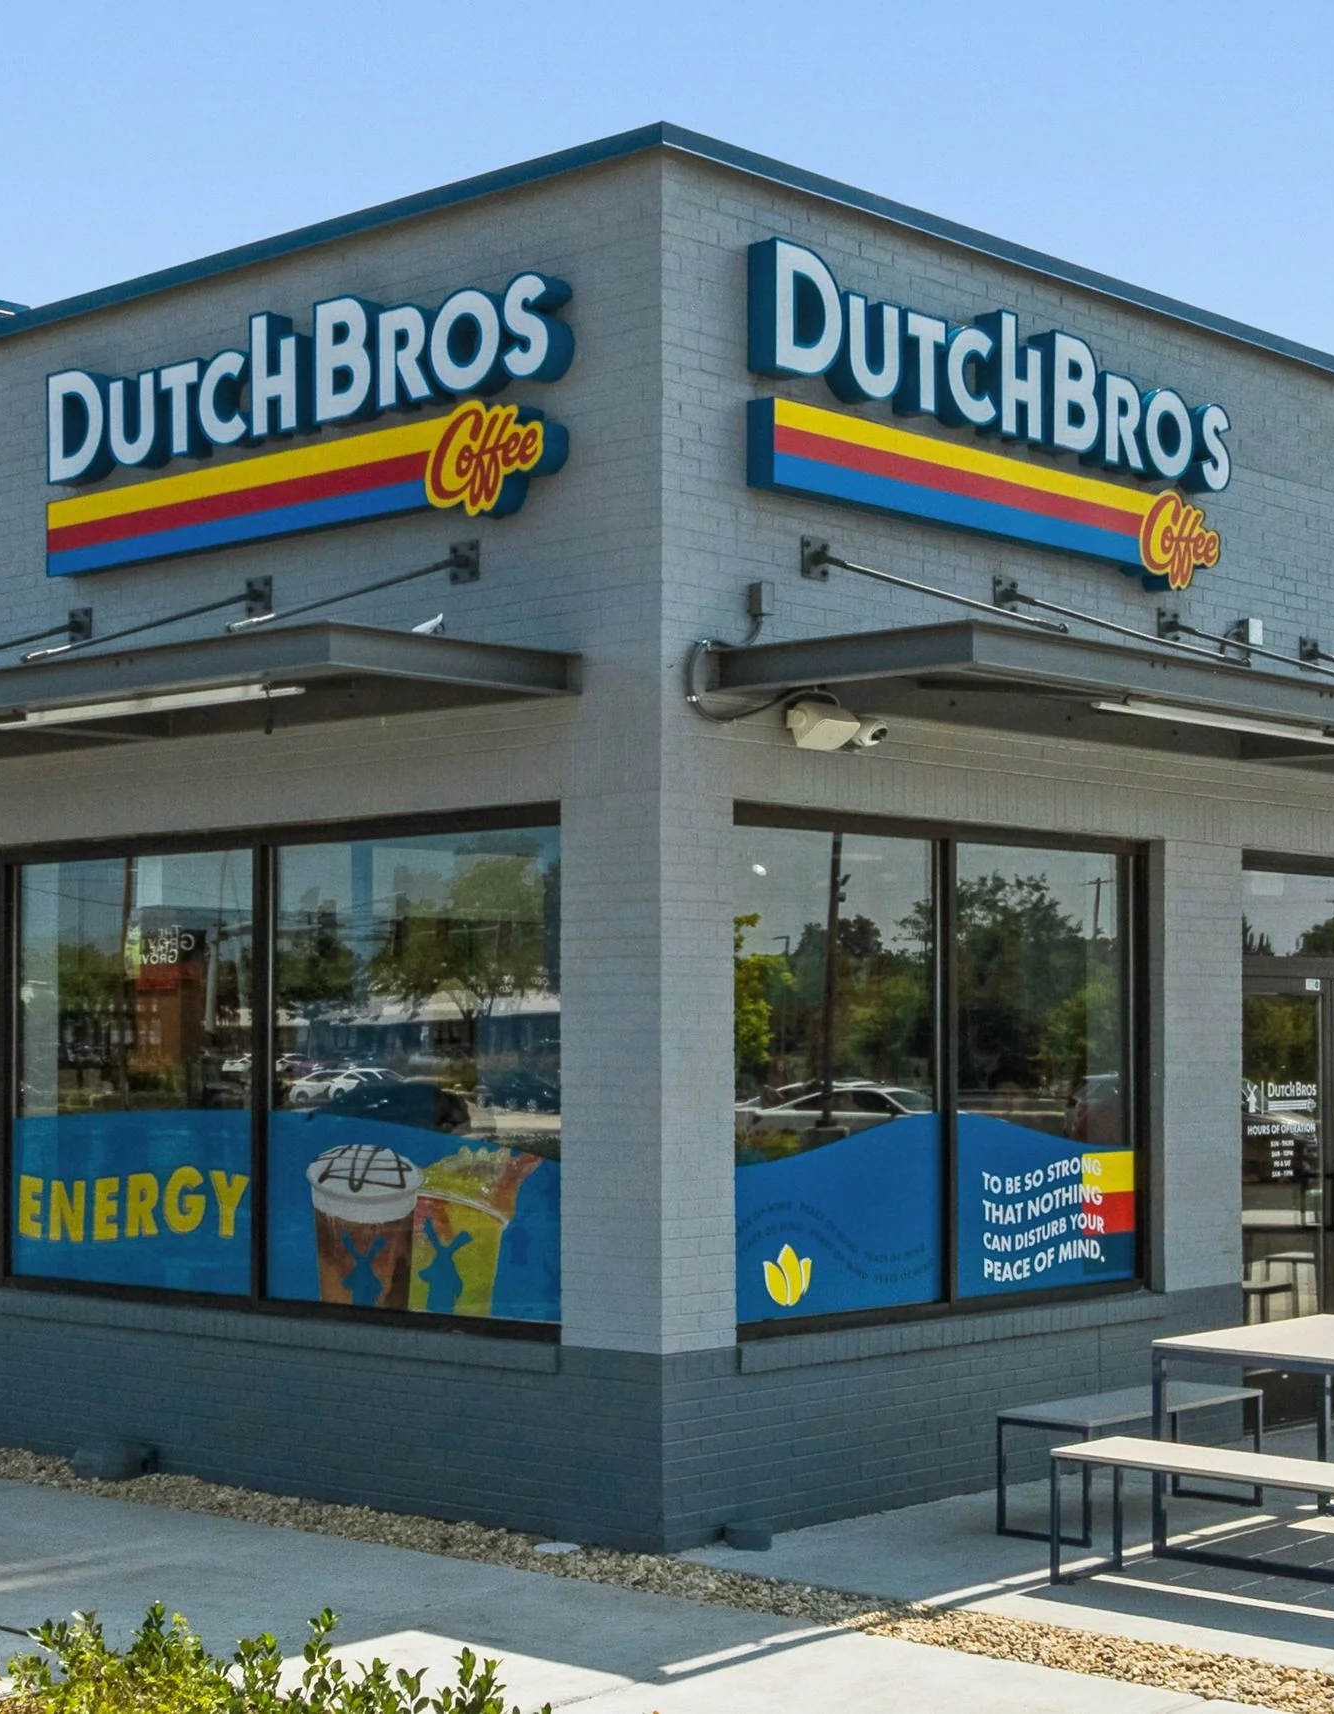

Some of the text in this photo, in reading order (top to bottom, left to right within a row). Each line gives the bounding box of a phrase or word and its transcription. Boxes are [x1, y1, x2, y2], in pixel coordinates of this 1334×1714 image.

[431, 407, 538, 509] Coffee
[1144, 494, 1219, 589] Coffee
[1247, 1122, 1316, 1135] HOURS OF OPERATION
[982, 1157, 1102, 1195] TO BE SO STRONG
[18, 1164, 250, 1243] ENERGY
[982, 1184, 1103, 1225] THAT NOTHING
[983, 1213, 1105, 1252] CAN DISTURB YOUR
[983, 1239, 1105, 1282] PEACE OF MIND.
